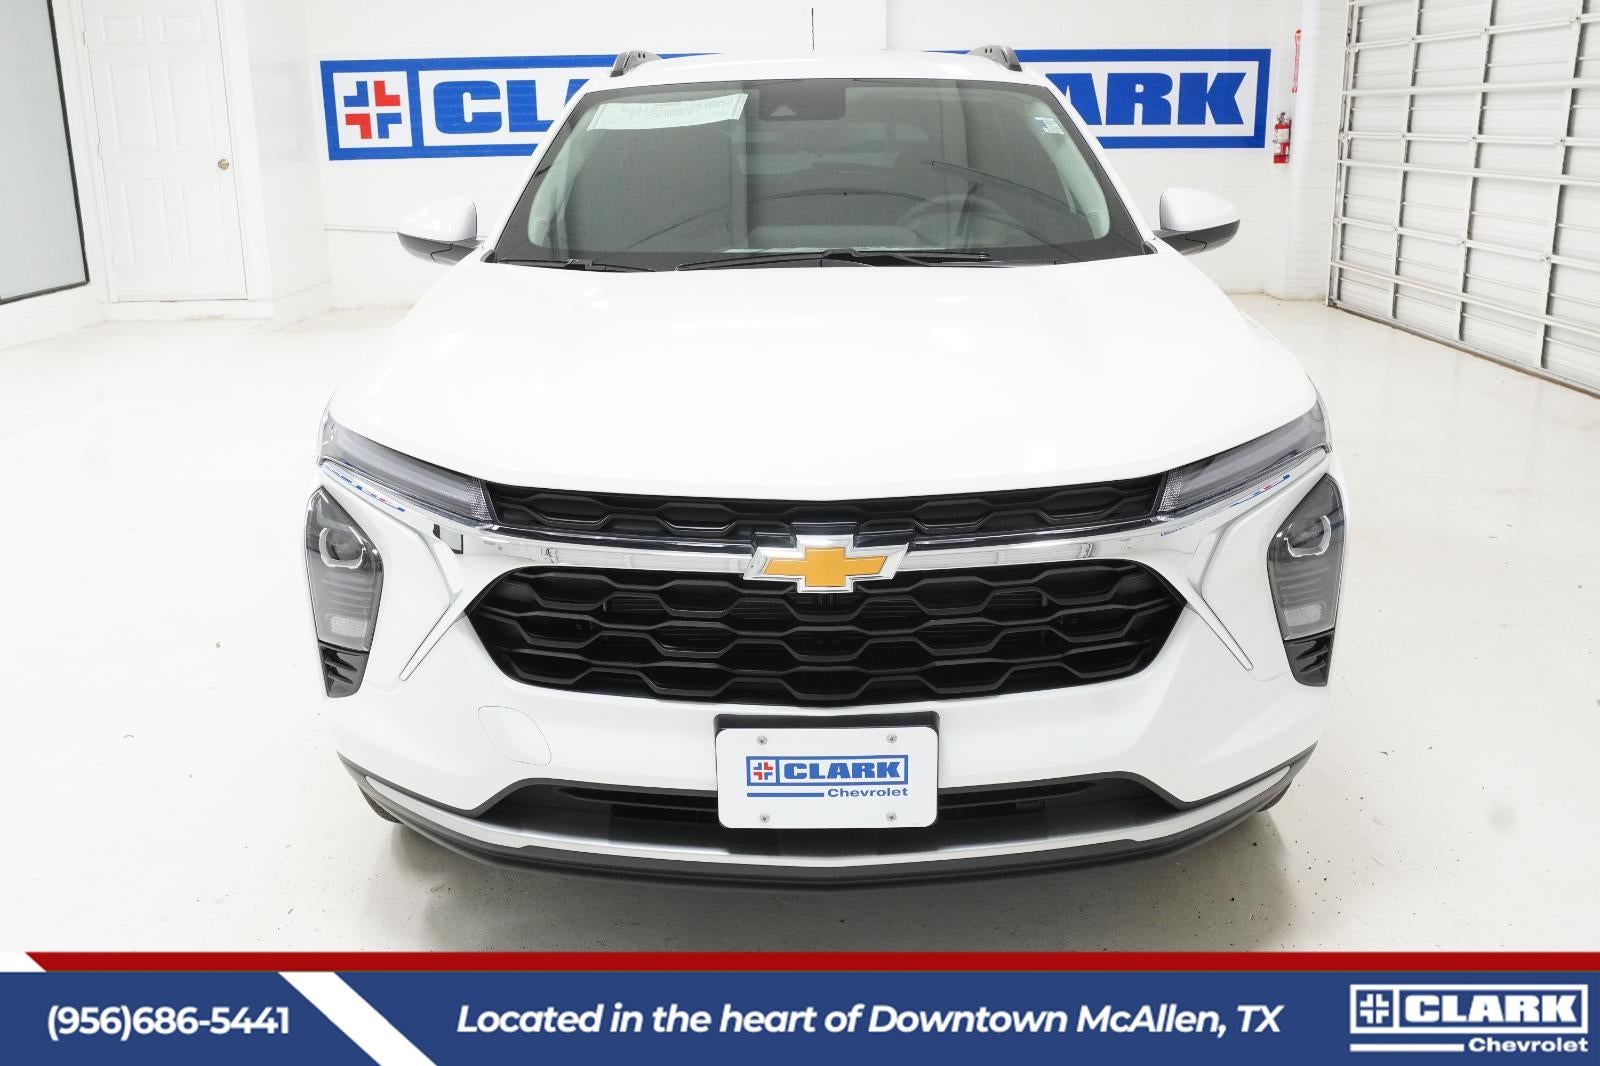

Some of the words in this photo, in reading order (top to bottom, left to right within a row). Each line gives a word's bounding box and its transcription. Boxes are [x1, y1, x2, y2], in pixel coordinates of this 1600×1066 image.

[433, 79, 588, 135] CL
[783, 761, 901, 780] CLARK
[827, 787, 909, 798] Chevrolet
